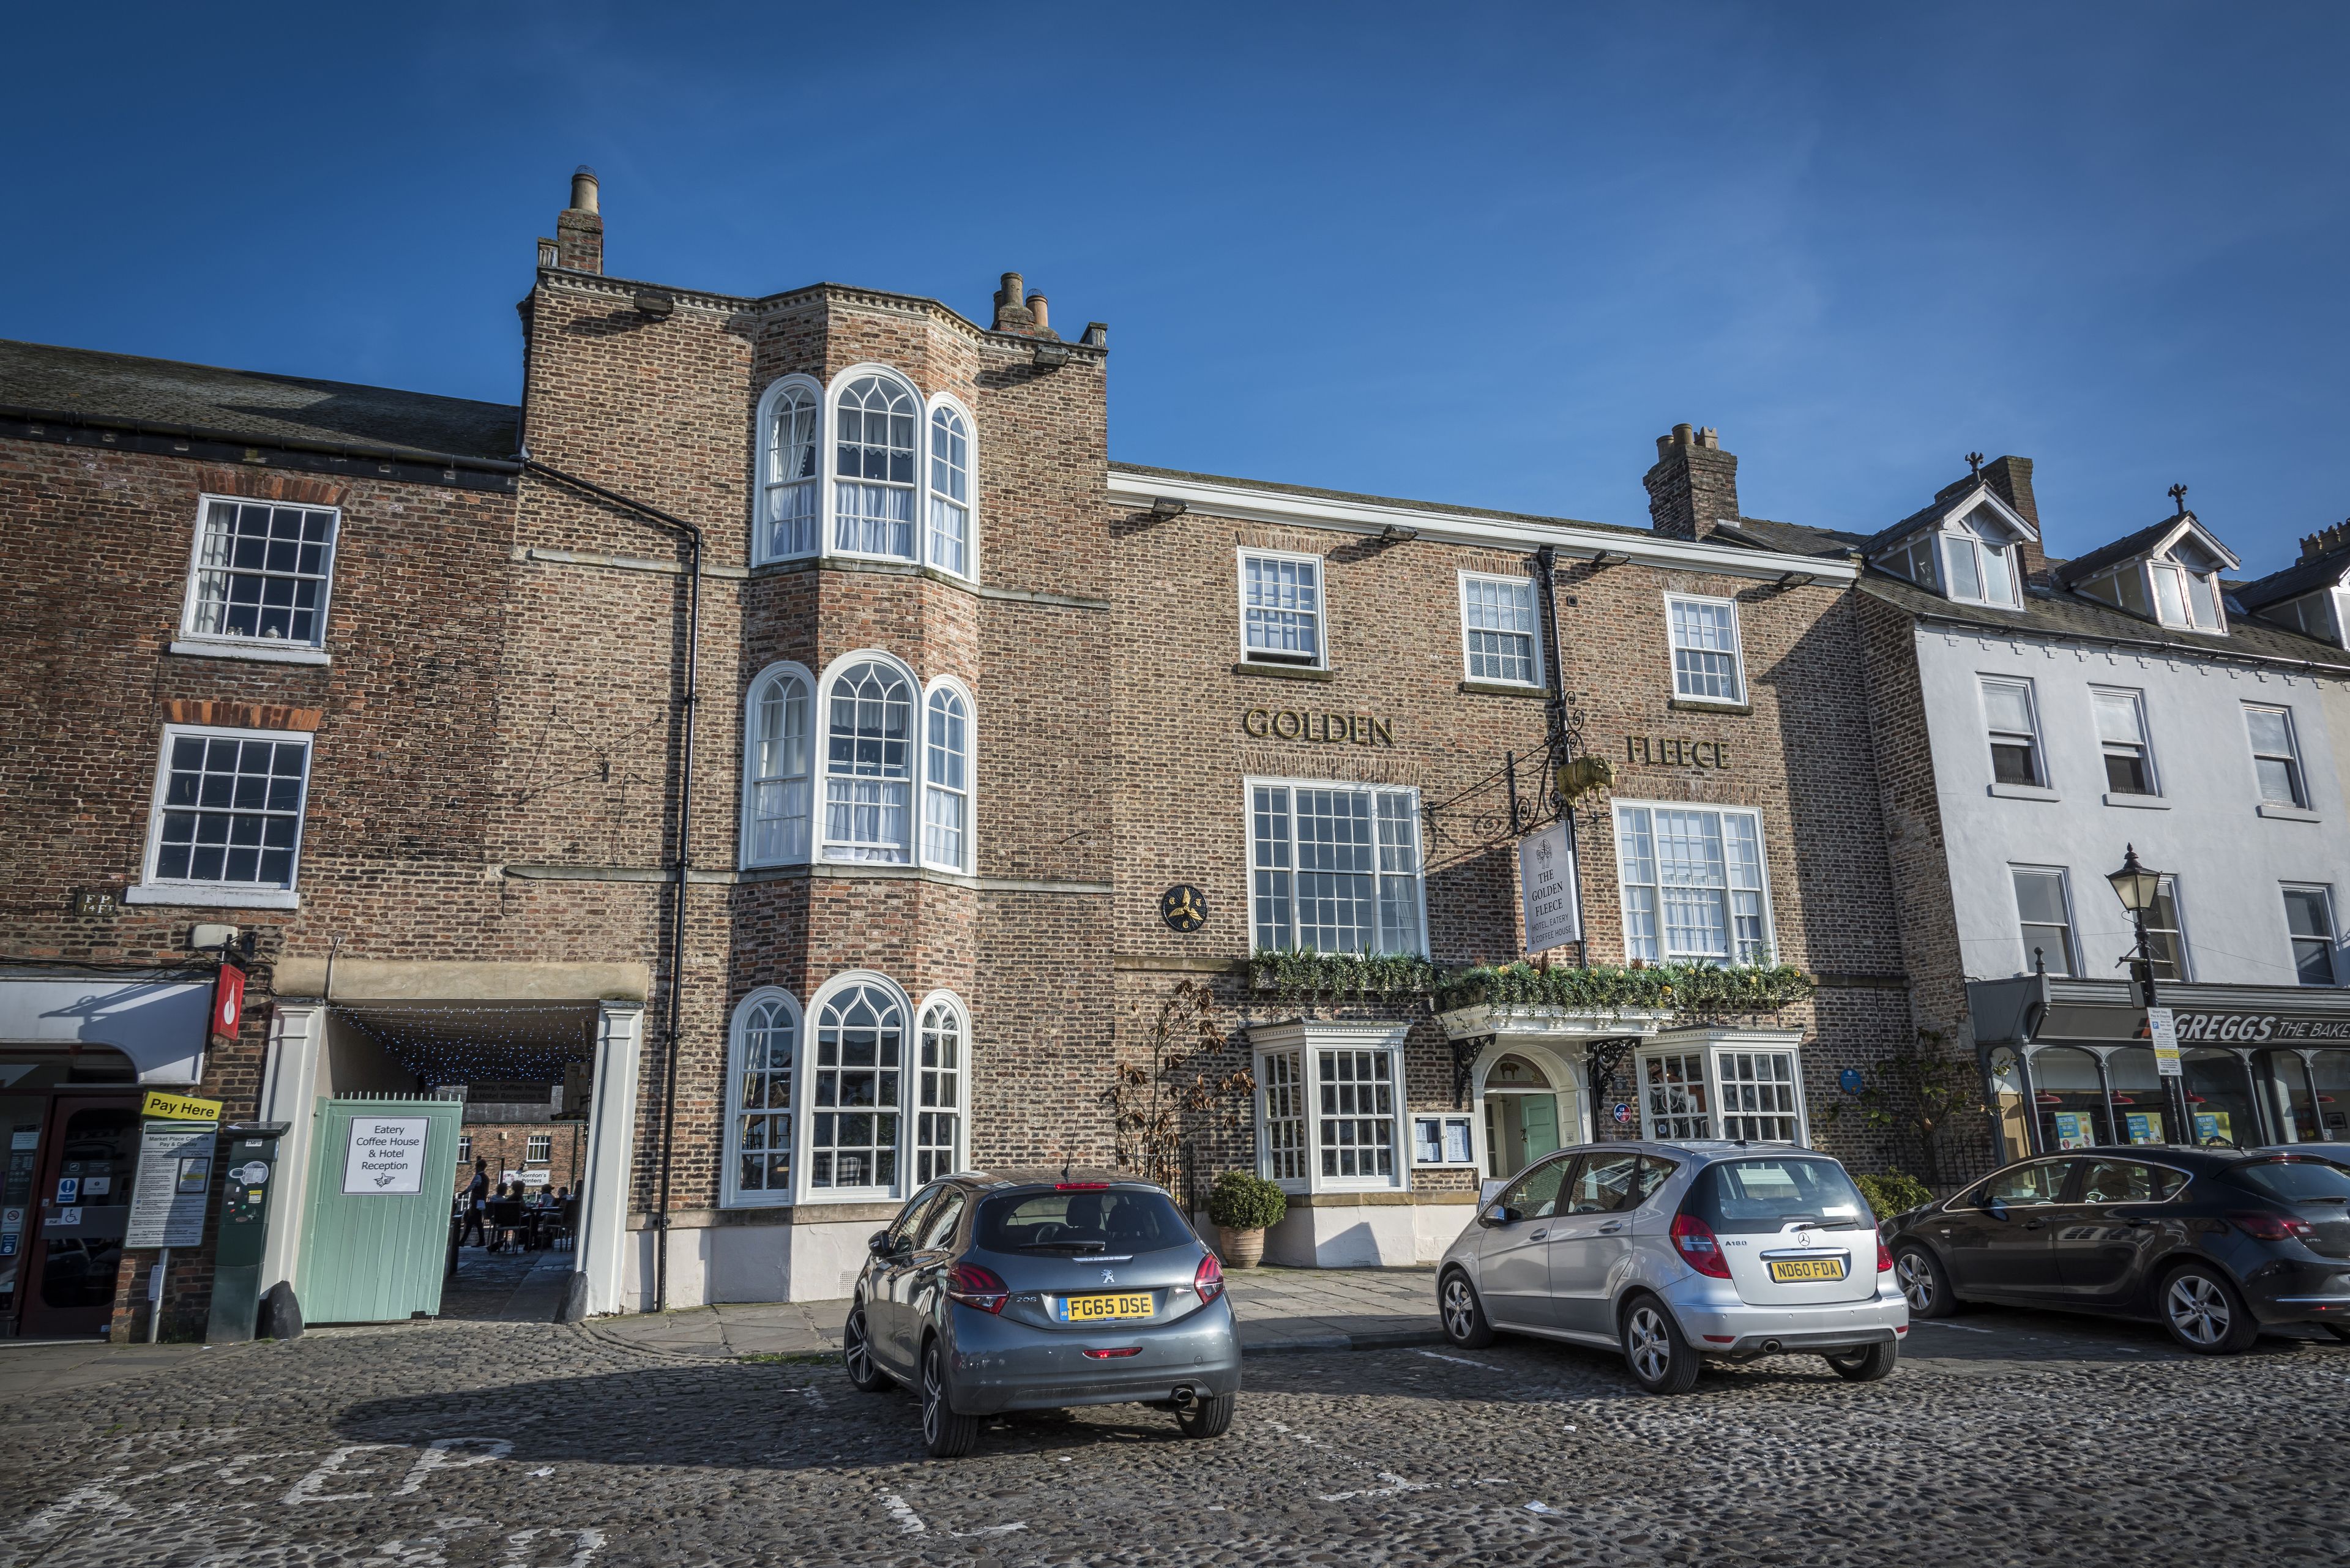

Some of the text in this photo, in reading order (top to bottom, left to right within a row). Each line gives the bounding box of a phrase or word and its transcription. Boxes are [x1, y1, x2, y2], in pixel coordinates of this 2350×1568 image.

[1245, 708, 1395, 746] GOLDEN
[1627, 735, 1733, 769] FLEECE
[1538, 869, 1554, 884] THE
[1532, 881, 1563, 902] GOLDEN
[1535, 898, 1563, 917] FLEECE
[1532, 913, 1569, 933] HOTEL, EATERY
[1535, 930, 1555, 943] COFFEE
[1554, 925, 1572, 937] HOUSE
[2173, 1014, 2350, 1040] GREGGS THE BAKE
[150, 1098, 214, 1117] Pay Here
[374, 1126, 405, 1135] Eatery
[356, 1137, 420, 1146] Coffee House
[368, 1149, 405, 1158] & Hotel
[361, 1162, 408, 1171] Reception
[1777, 1261, 1838, 1277] ND60 FDA
[1070, 1297, 1150, 1316] FG65 DSE
